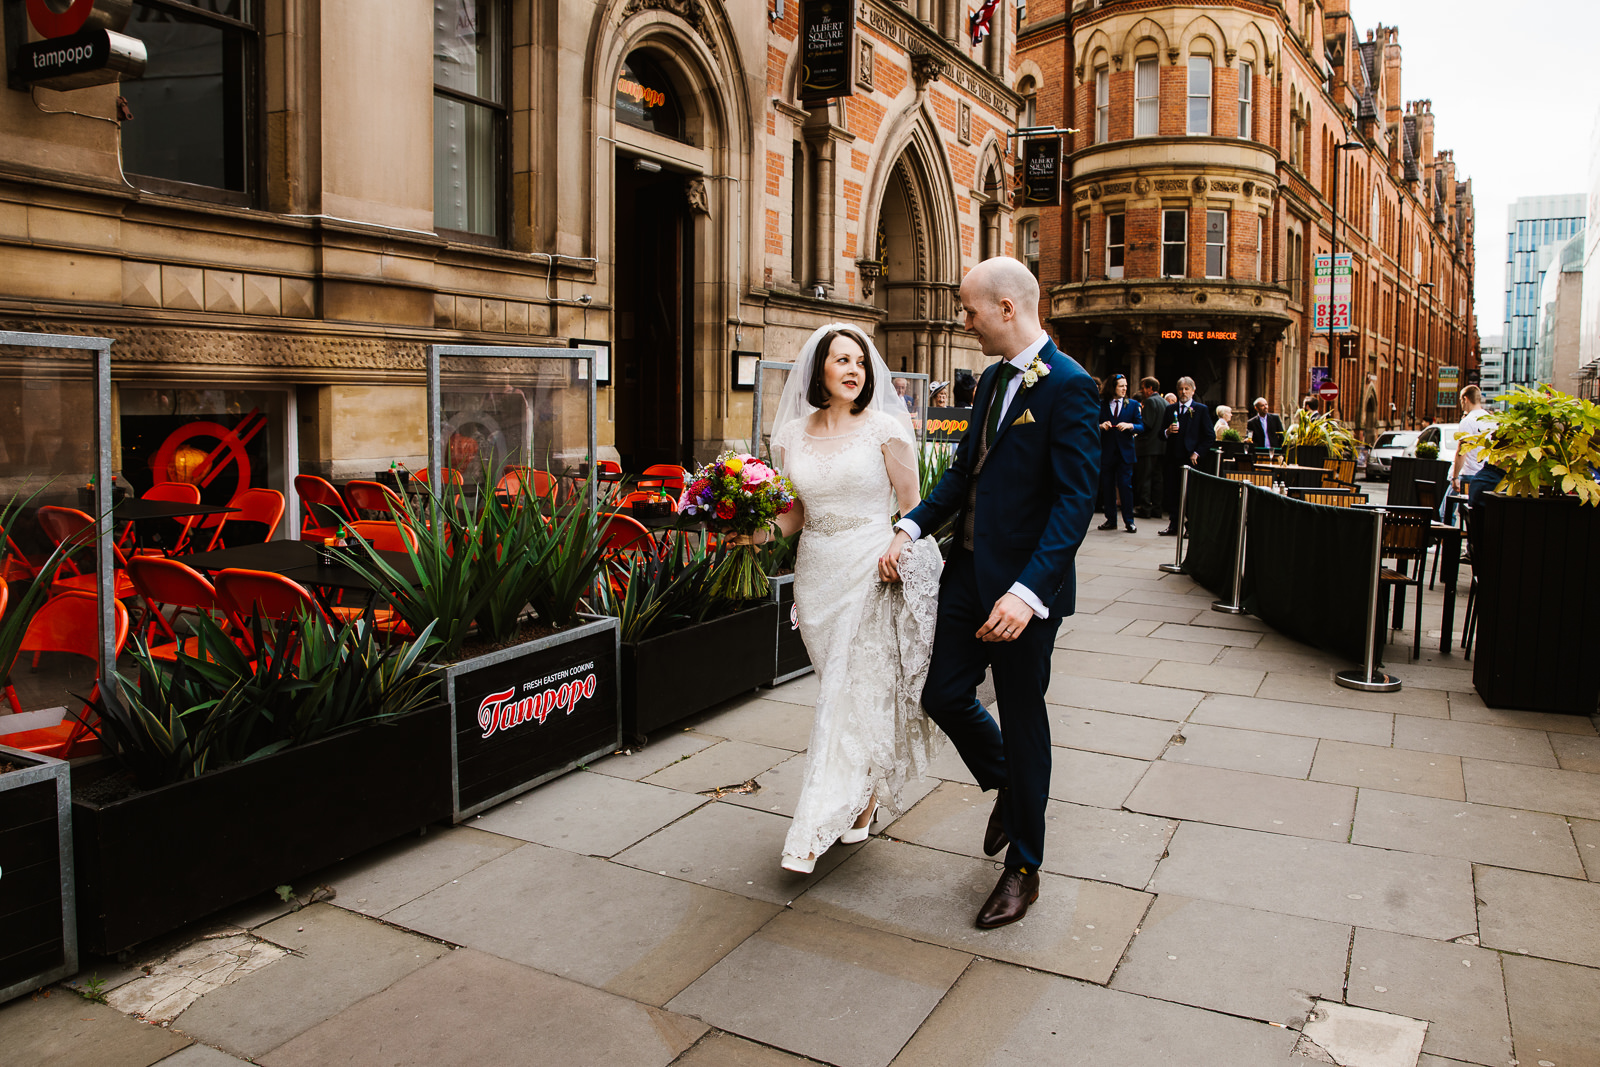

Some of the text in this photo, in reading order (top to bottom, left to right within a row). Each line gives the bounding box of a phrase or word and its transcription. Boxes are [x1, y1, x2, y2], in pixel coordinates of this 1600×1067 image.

[810, 22, 844, 33] ALBERT
[809, 30, 844, 42] SQUARE
[825, 39, 843, 48] House
[33, 44, 93, 68] tampopo
[617, 70, 665, 107] ampopo
[1317, 267, 1349, 276] OFFCES
[1317, 294, 1348, 302] OFFCES
[1317, 303, 1348, 317] 832
[1317, 317, 1348, 327] 8321
[1161, 330, 1237, 340] RED'S TRUE BARBECUE
[523, 661, 594, 692] FRESH EASTERN COOKING
[478, 673, 597, 739] Tampopo
